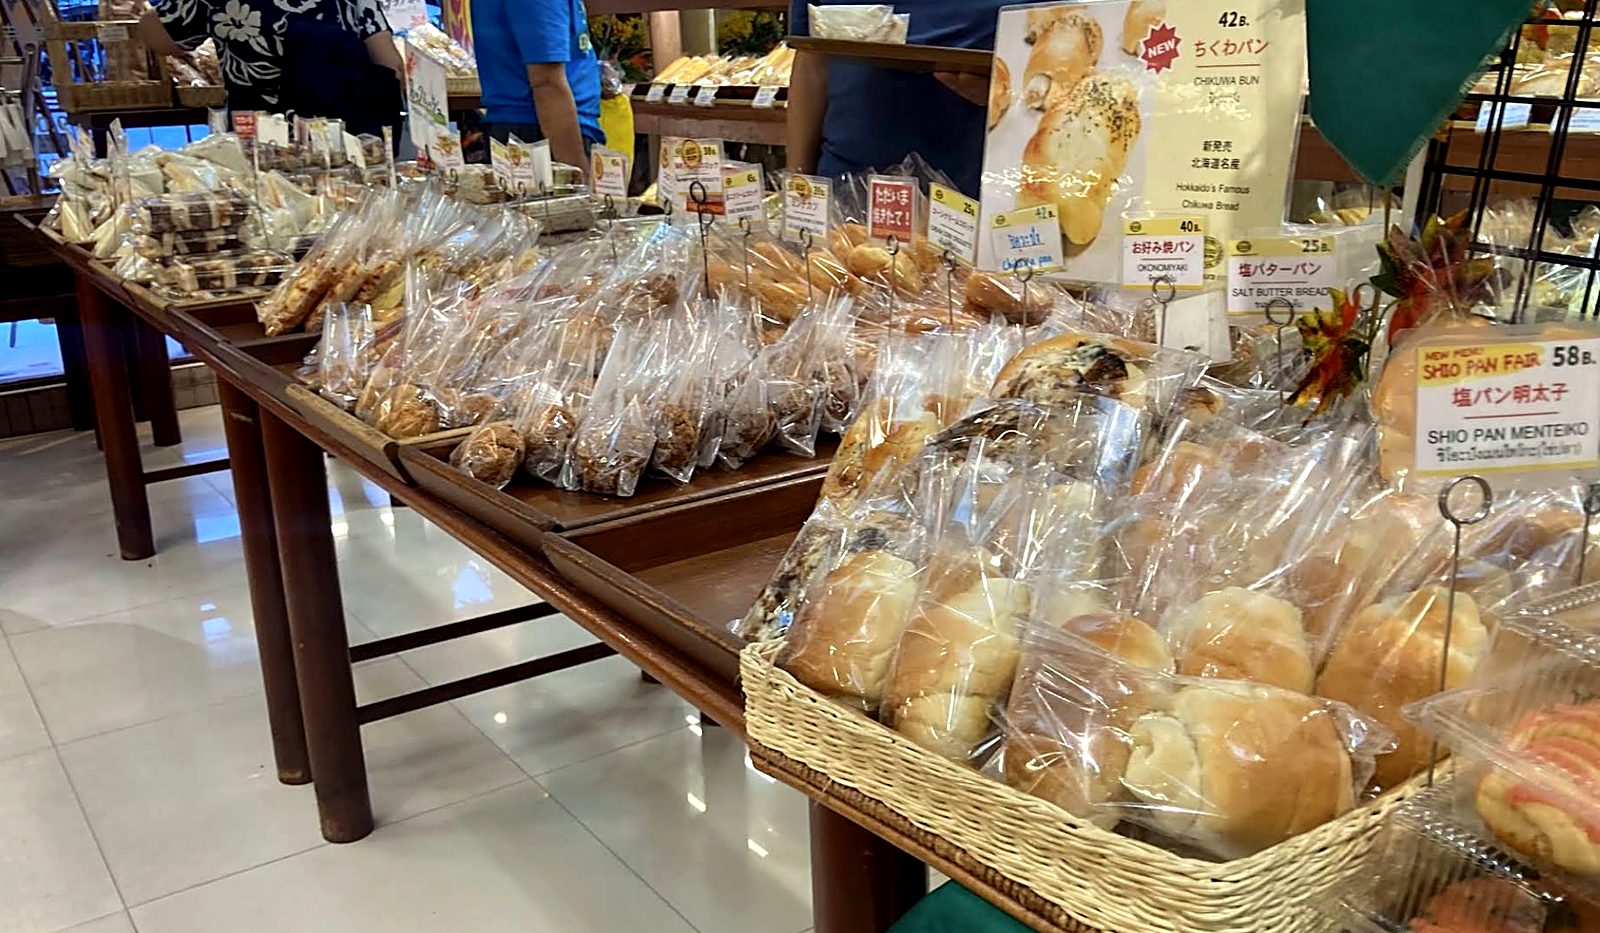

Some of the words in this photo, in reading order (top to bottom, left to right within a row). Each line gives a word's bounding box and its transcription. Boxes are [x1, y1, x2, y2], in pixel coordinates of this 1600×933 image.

[1147, 38, 1175, 58] NEW
[1193, 39, 1269, 58] ちくわパン
[1193, 77, 1236, 86] CHIKUWA
[1239, 75, 1260, 85] BUN
[1203, 140, 1233, 153] 新発売
[1191, 157, 1240, 170] 北海道名産
[875, 186, 909, 206] ただいま
[1176, 182, 1217, 193] Hokkaido's
[1218, 183, 1250, 195] Famous
[1215, 201, 1240, 211] Bread
[1132, 240, 1195, 255] お好み焼パン
[1137, 263, 1189, 273] OKONOMIYAKI
[1238, 262, 1322, 278] 塩バターパン
[1231, 287, 1254, 297] SALT
[1256, 287, 1294, 297] BUTTER
[1295, 286, 1330, 297] BREAD
[1423, 362, 1462, 380] SHIO
[1465, 356, 1499, 376] PAN
[1504, 352, 1541, 370] FAIR
[1452, 383, 1569, 407] 塩パン明太子
[1427, 429, 1469, 445] SHIO
[1472, 426, 1507, 442] PAN
[1511, 422, 1590, 440] MENTEIKO
